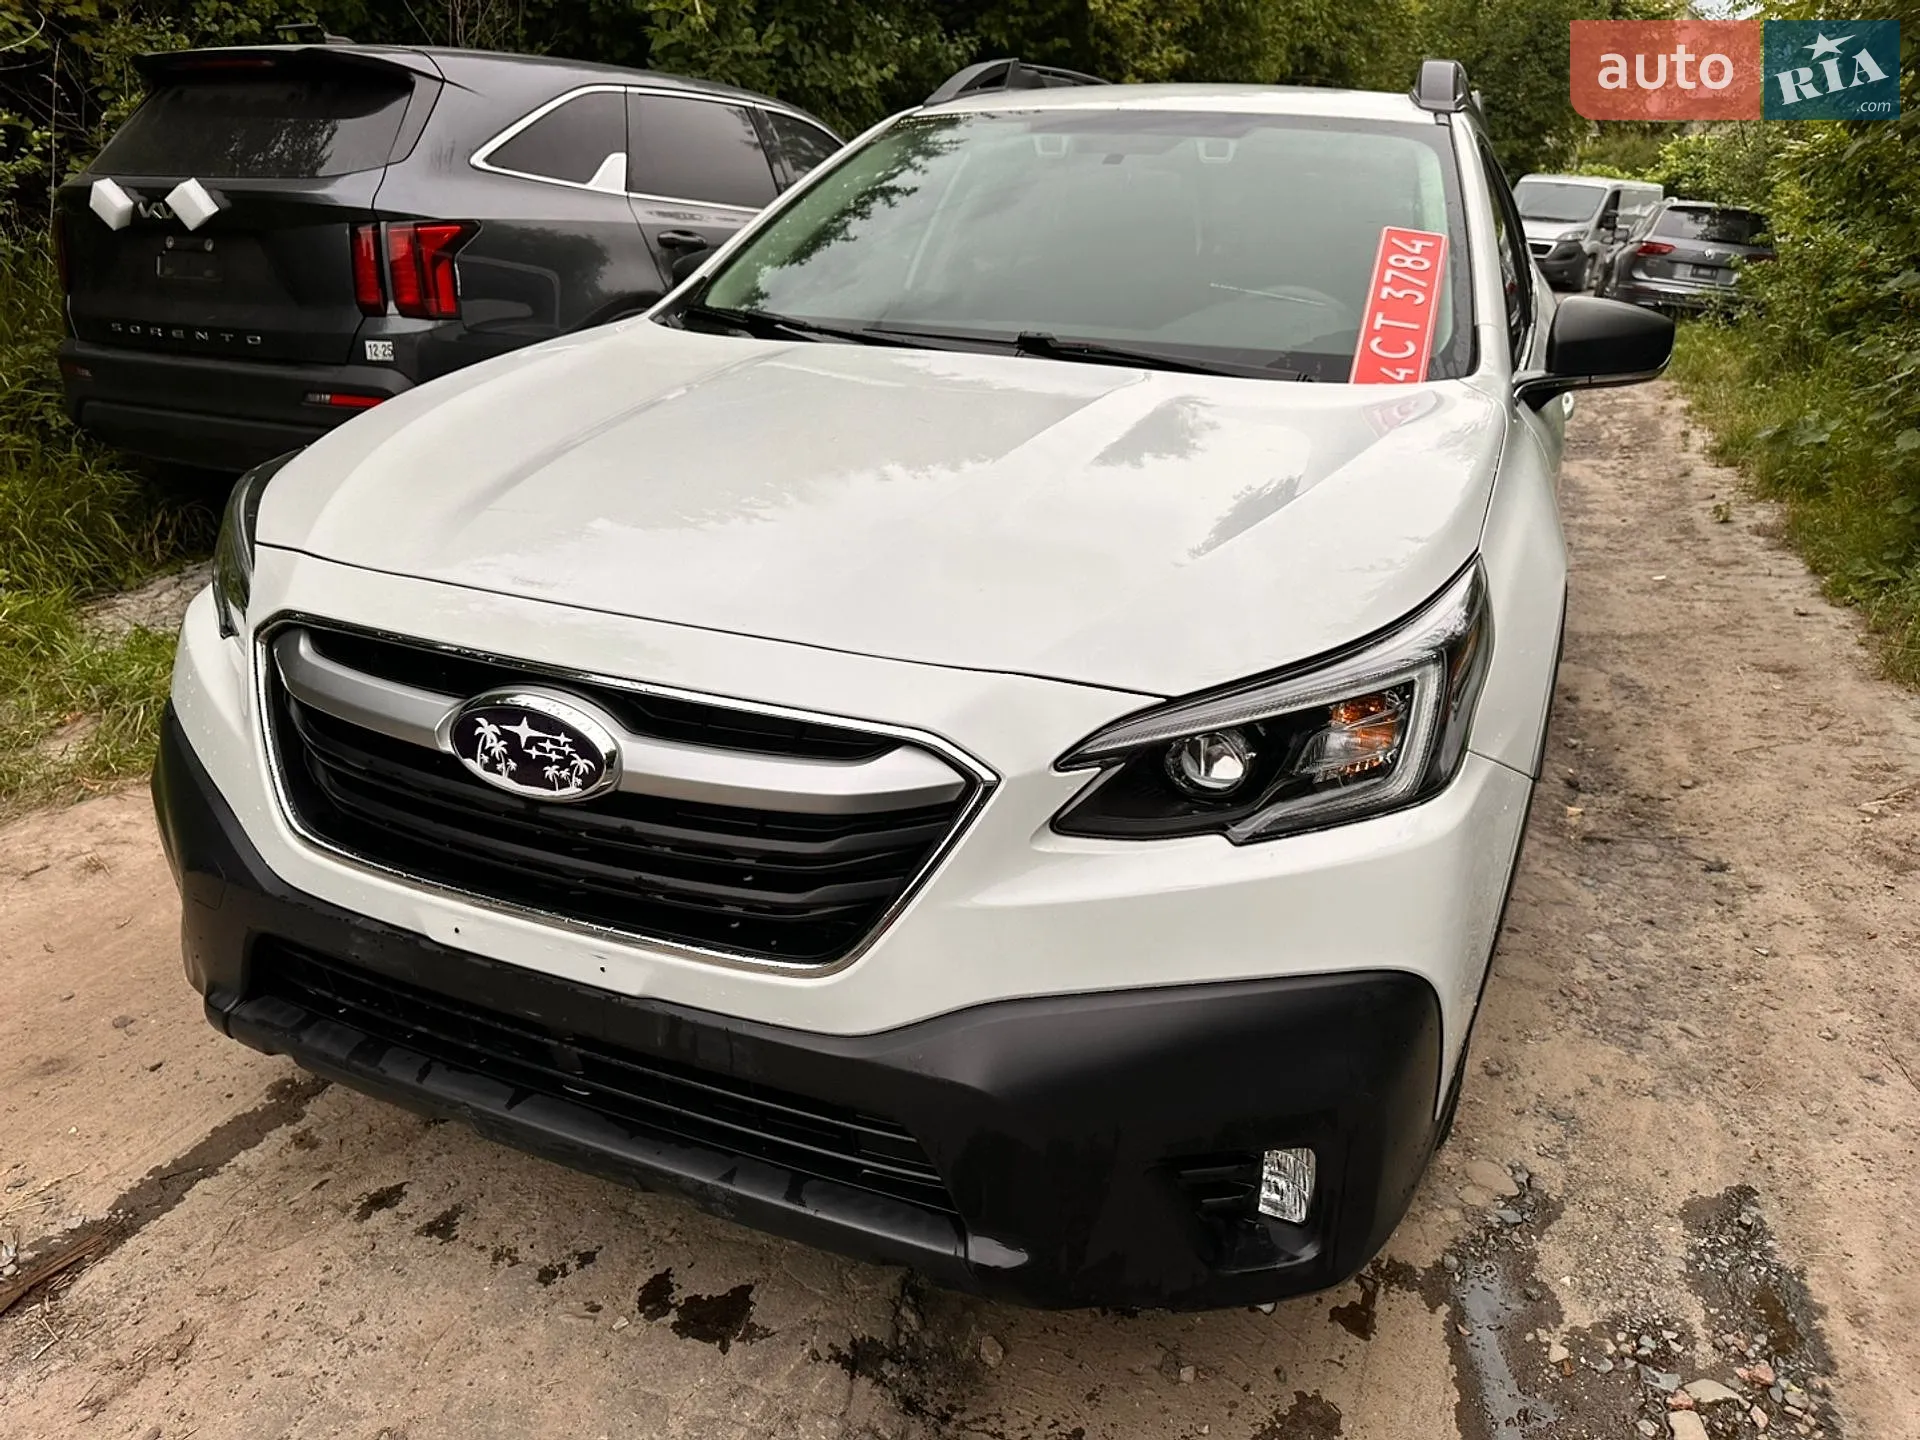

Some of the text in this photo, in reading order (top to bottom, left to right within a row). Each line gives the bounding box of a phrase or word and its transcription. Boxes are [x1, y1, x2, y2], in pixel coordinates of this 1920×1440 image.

[138, 201, 175, 219] KI
[1379, 236, 1434, 306] 3784
[111, 322, 262, 345] SORENTO
